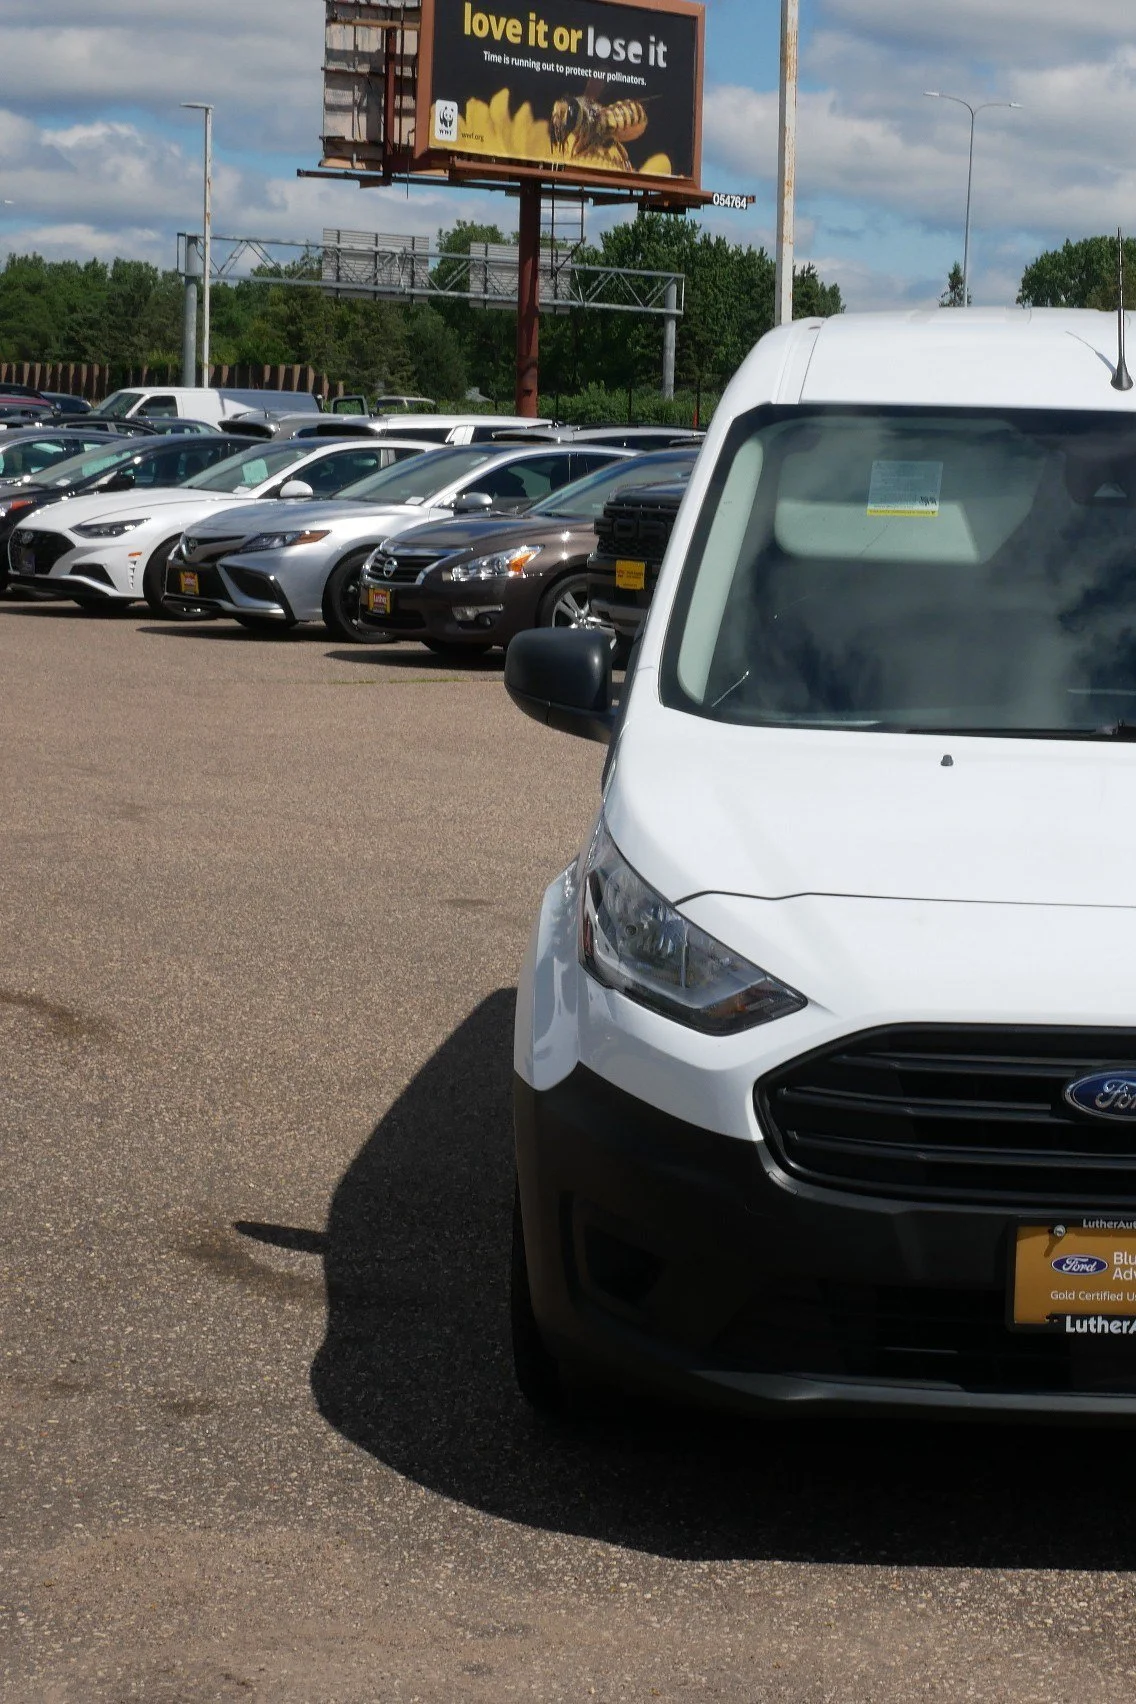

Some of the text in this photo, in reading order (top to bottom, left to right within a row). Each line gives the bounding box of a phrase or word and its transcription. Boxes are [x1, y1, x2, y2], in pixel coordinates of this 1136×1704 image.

[464, 2, 668, 68] love it or lose it
[483, 50, 647, 86] Time is running out to protect our pollinators.
[712, 192, 747, 210] 054764
[1062, 1257, 1097, 1273] Ford
[1050, 1290, 1075, 1300] Gold
[1078, 1290, 1123, 1301] Certified
